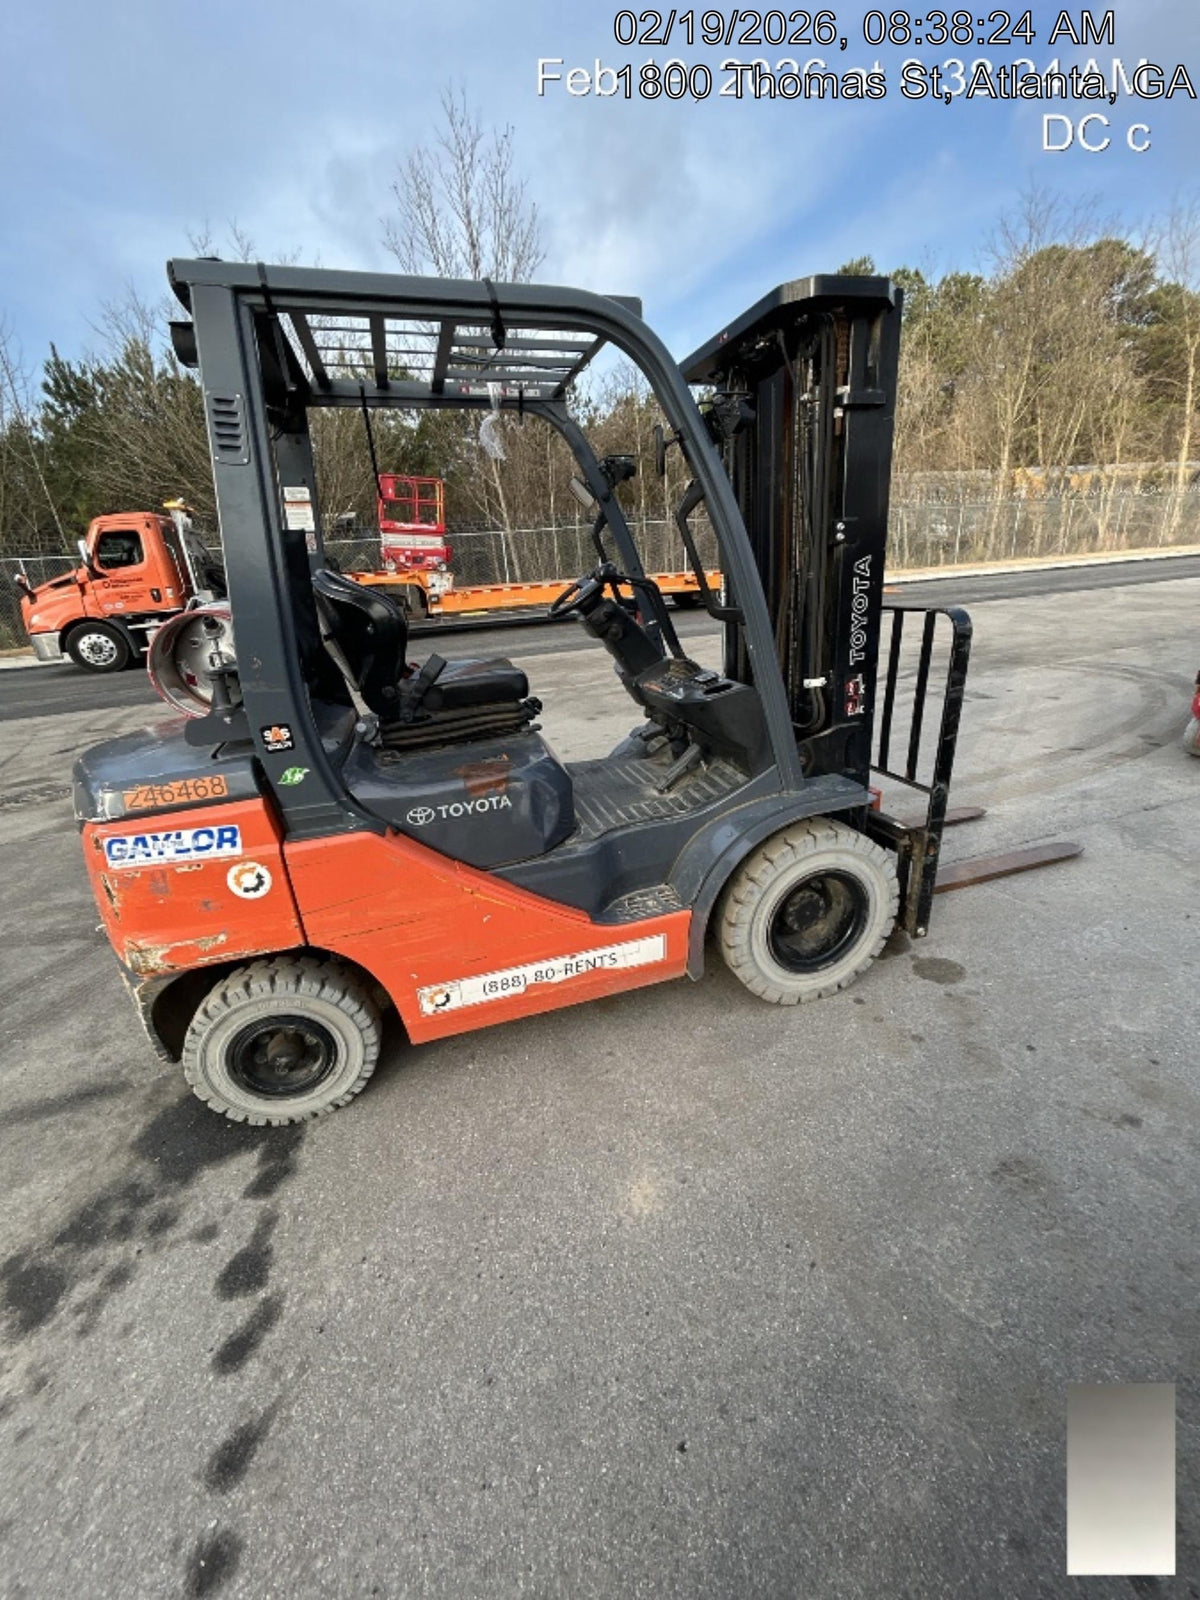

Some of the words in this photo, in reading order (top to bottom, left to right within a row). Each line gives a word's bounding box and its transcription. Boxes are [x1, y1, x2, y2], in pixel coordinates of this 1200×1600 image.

[850, 555, 872, 665] TOYOTA
[437, 795, 512, 818] TOYOTA
[483, 973, 527, 996] (888)
[534, 951, 618, 982] 80-RENTS
